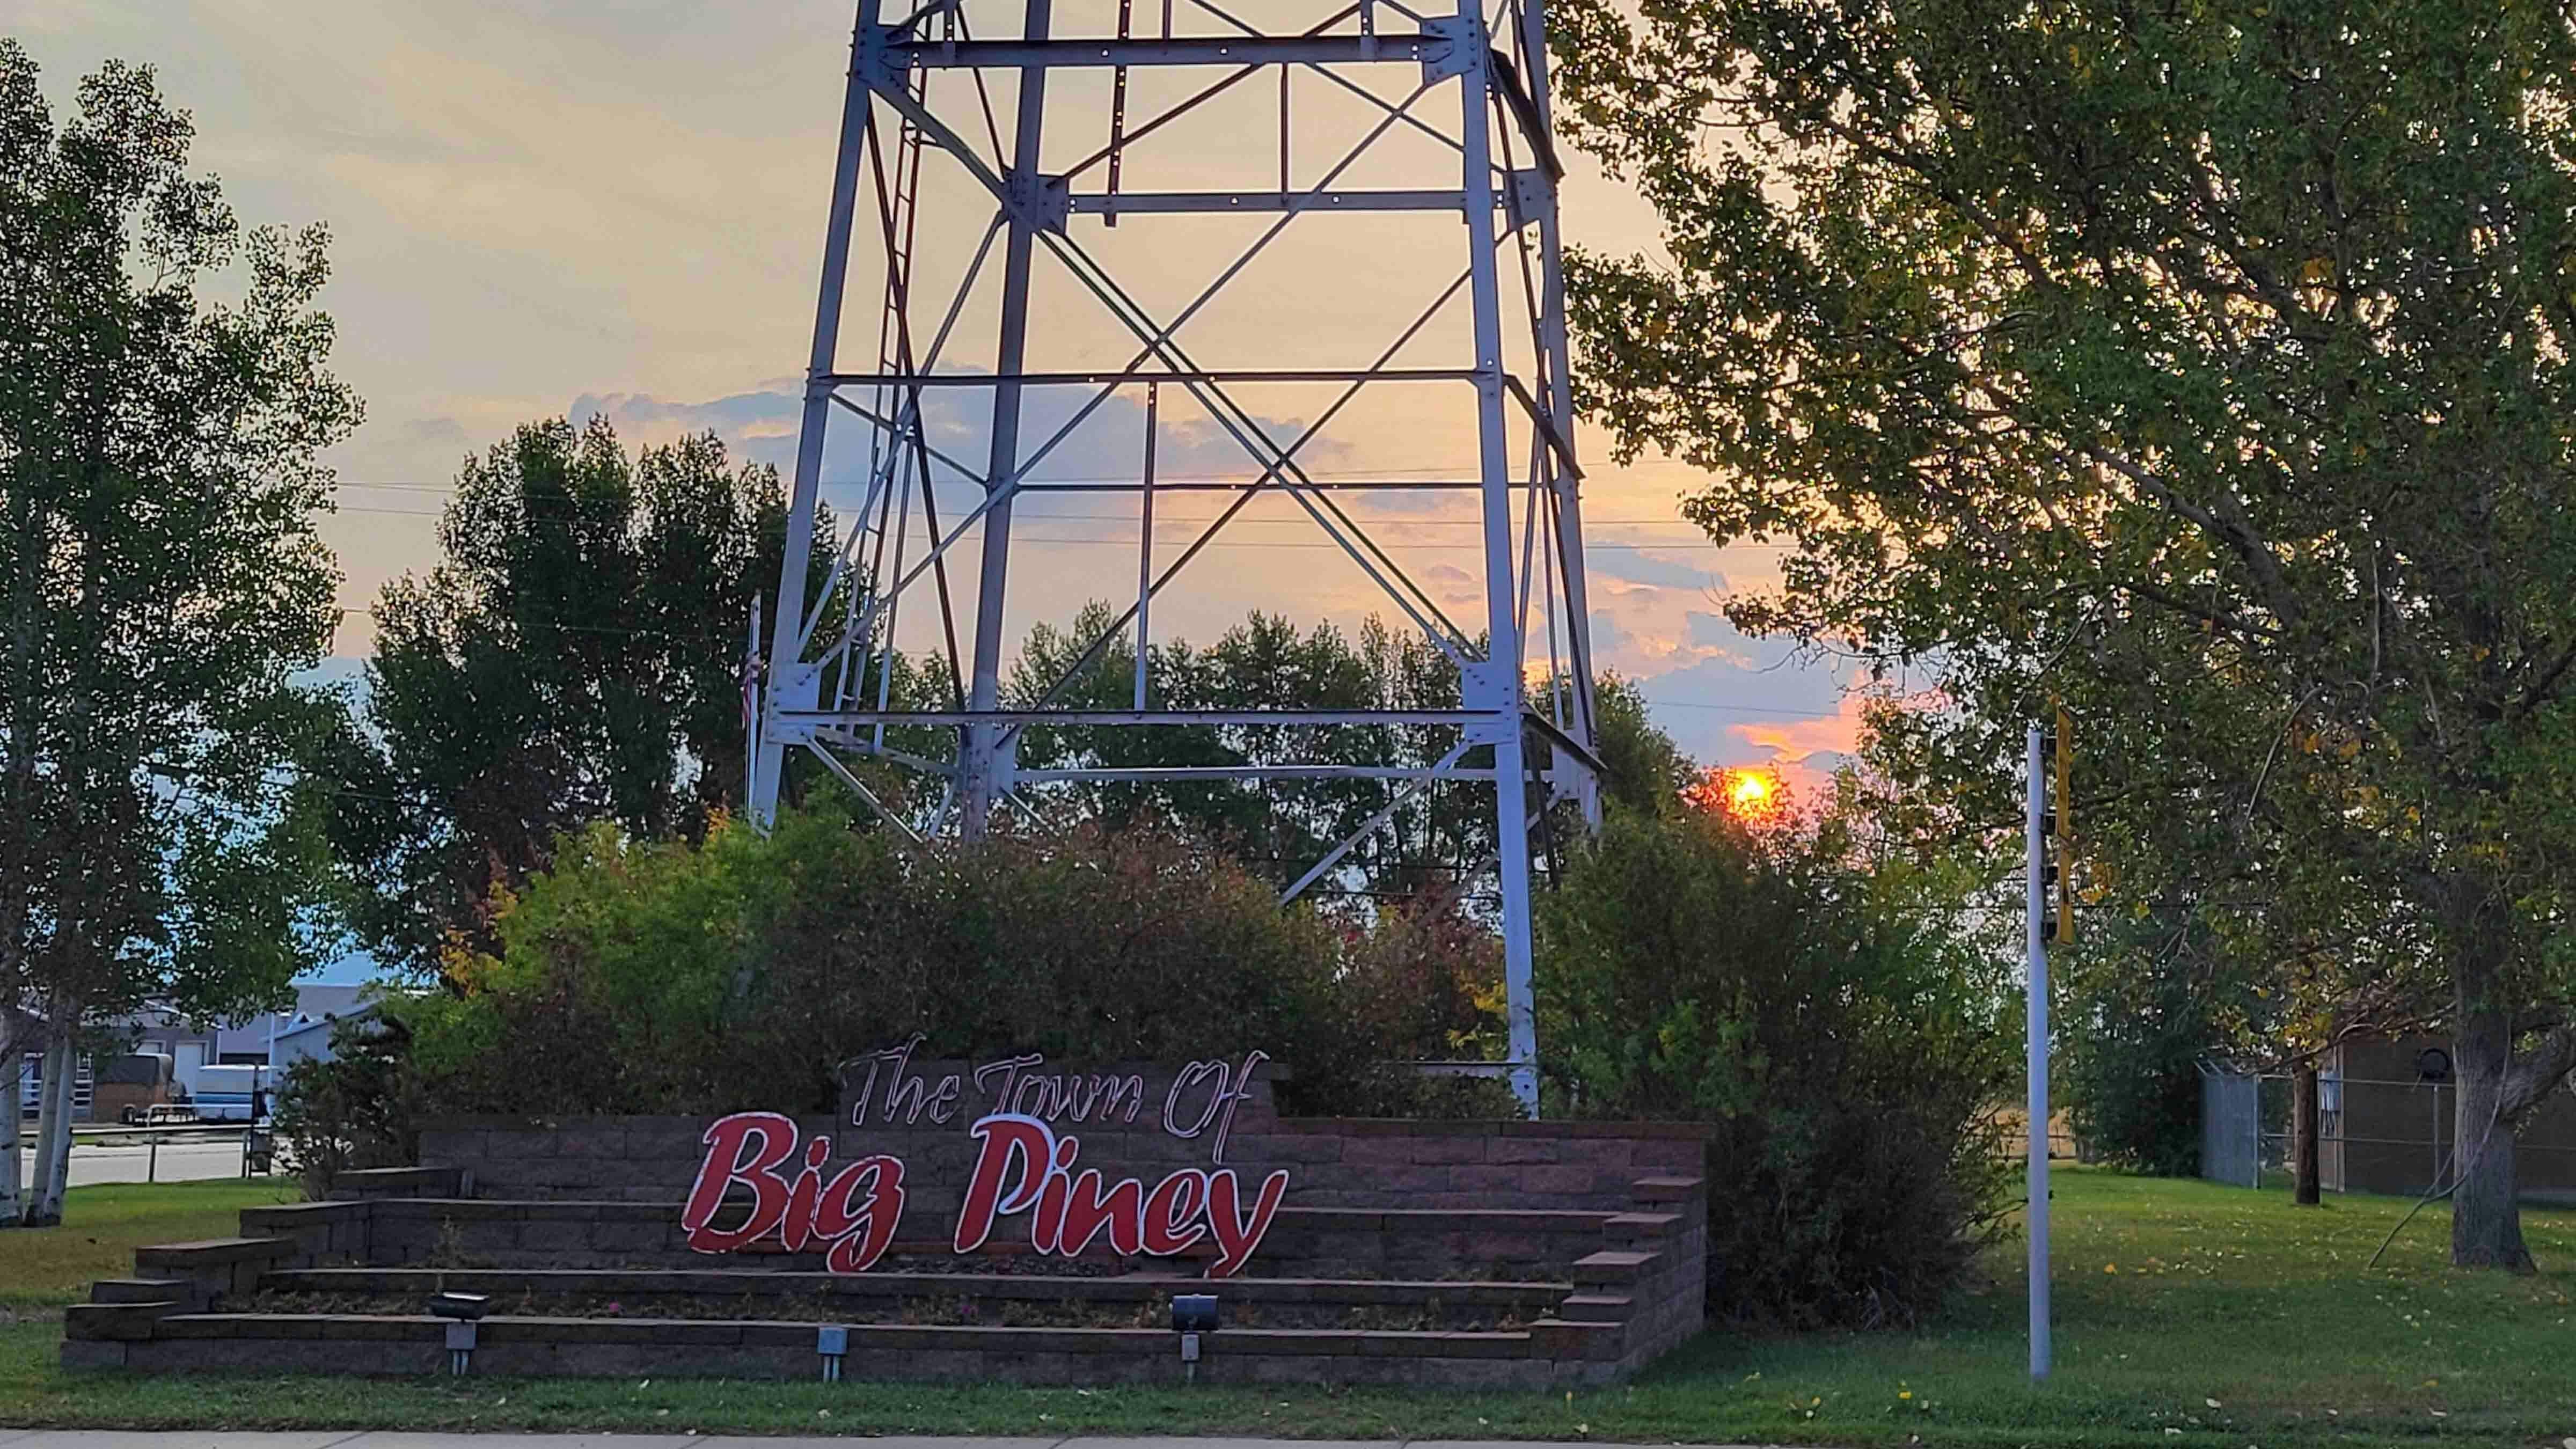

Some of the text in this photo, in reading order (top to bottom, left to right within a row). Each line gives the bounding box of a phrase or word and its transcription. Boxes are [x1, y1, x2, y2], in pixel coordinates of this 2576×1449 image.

[839, 1032, 1270, 1164] The Town Of
[680, 1111, 1290, 1279] Big Piney
